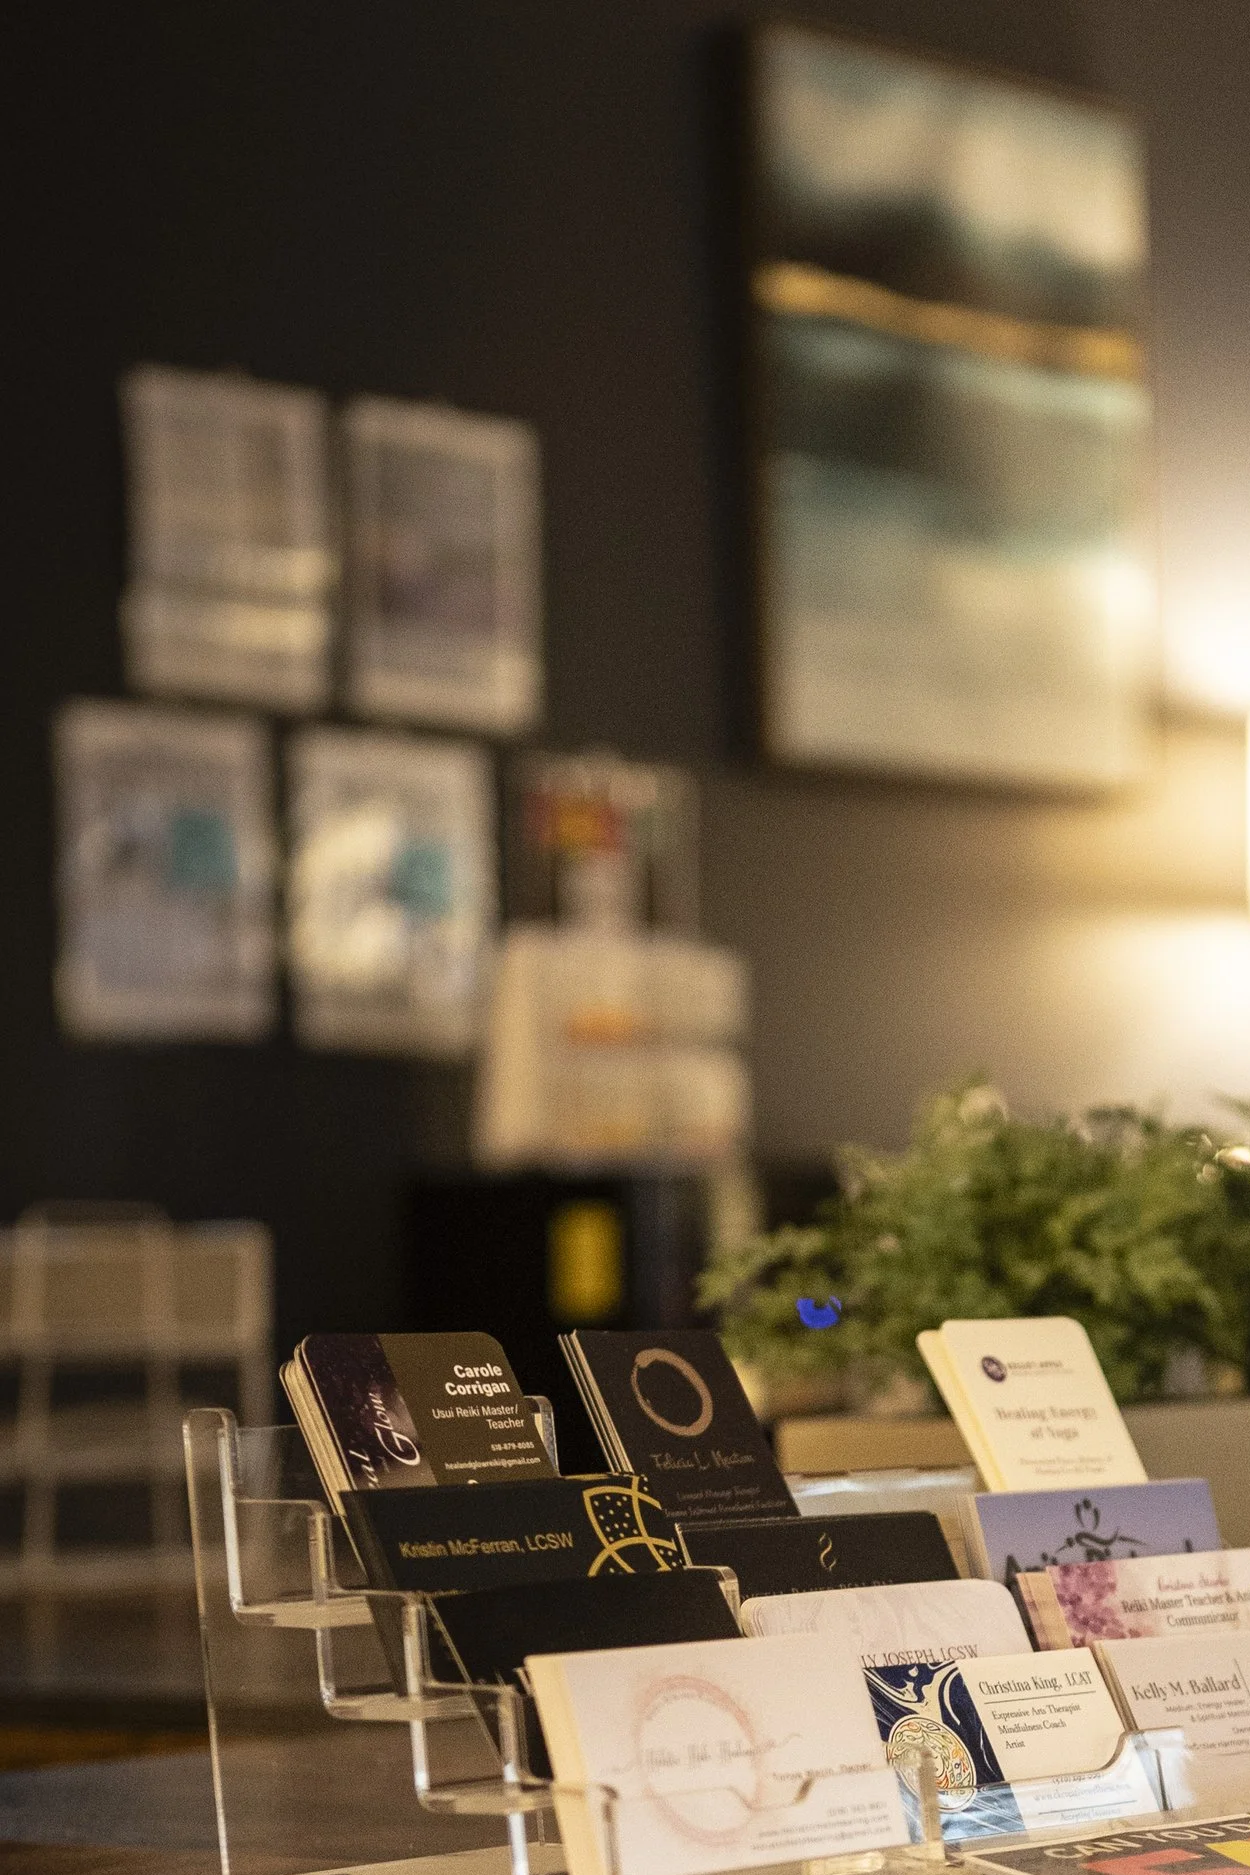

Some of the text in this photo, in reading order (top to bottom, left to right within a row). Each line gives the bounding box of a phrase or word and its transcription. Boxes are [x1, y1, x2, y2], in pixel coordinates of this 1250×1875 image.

[453, 1363, 503, 1379] Carole
[445, 1381, 511, 1397] Corrigan
[432, 1404, 519, 1419] Usui Reiki Master/
[368, 1392, 421, 1466] Glow
[486, 1418, 525, 1430] Teacher
[399, 1532, 574, 1559] Kristin McFerran, LCSW
[1121, 1599, 1149, 1614] Reiki
[1149, 1596, 1184, 1611] Master
[1184, 1593, 1224, 1608] Teacher
[1224, 1590, 1234, 1604] &
[1166, 1610, 1239, 1628] Communicator
[882, 1649, 940, 1666] JOSEPH,
[941, 1643, 979, 1662] LCSW
[978, 1671, 1093, 1696] Christina King, LCAT
[1131, 1673, 1242, 1702] Kelly M. Ballard
[991, 1703, 1082, 1722] Expressive Arts Therapist
[1198, 1701, 1222, 1711] Energy
[1196, 1712, 1227, 1723] Spiritual
[997, 1719, 1067, 1735] Mindfulness Coach
[1005, 1739, 1026, 1750] Artist
[1043, 1836, 1134, 1860] CAN
[1134, 1825, 1224, 1847] YOU
